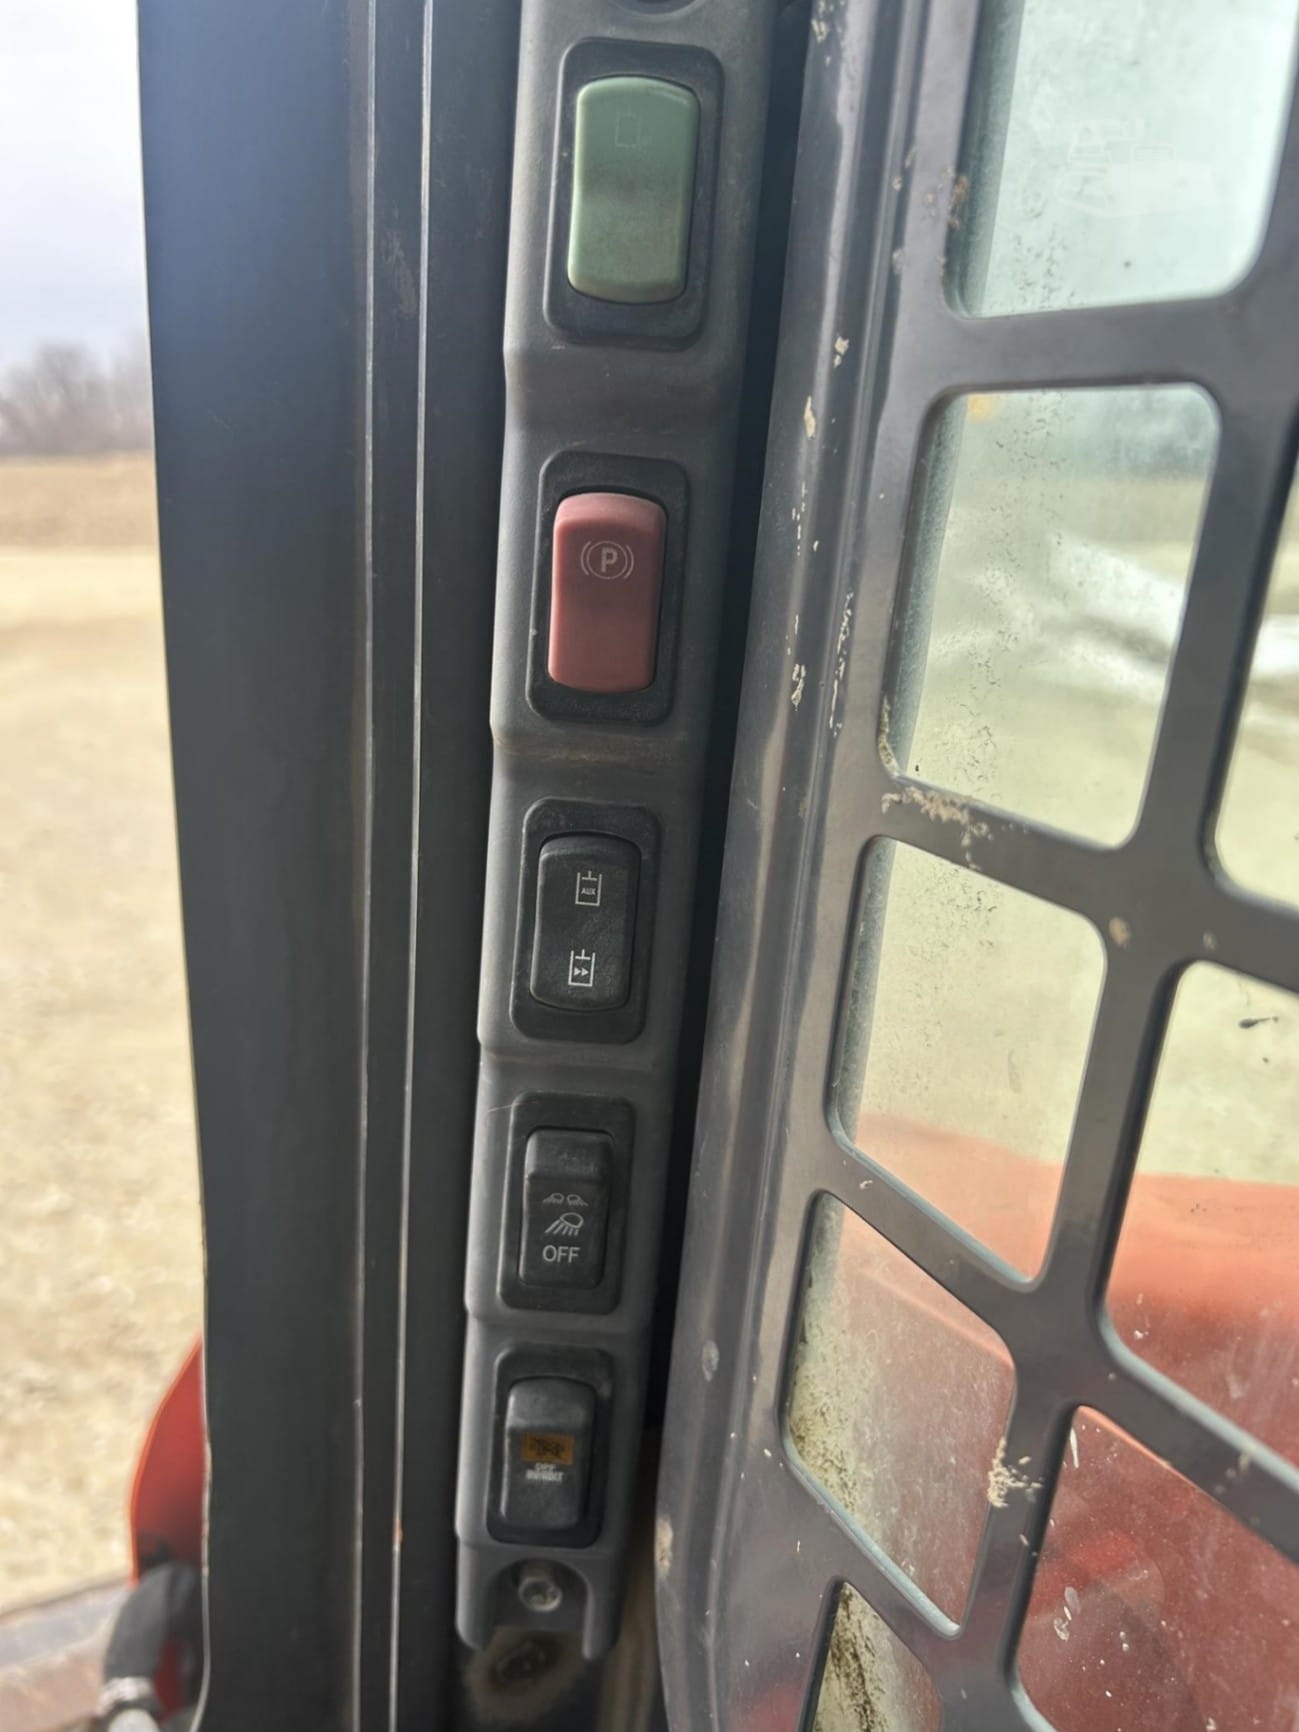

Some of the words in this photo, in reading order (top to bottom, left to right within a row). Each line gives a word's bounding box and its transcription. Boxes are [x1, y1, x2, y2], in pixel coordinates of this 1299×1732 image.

[601, 547, 618, 573] P
[581, 887, 596, 896] AUX
[542, 1244, 581, 1263] OFF
